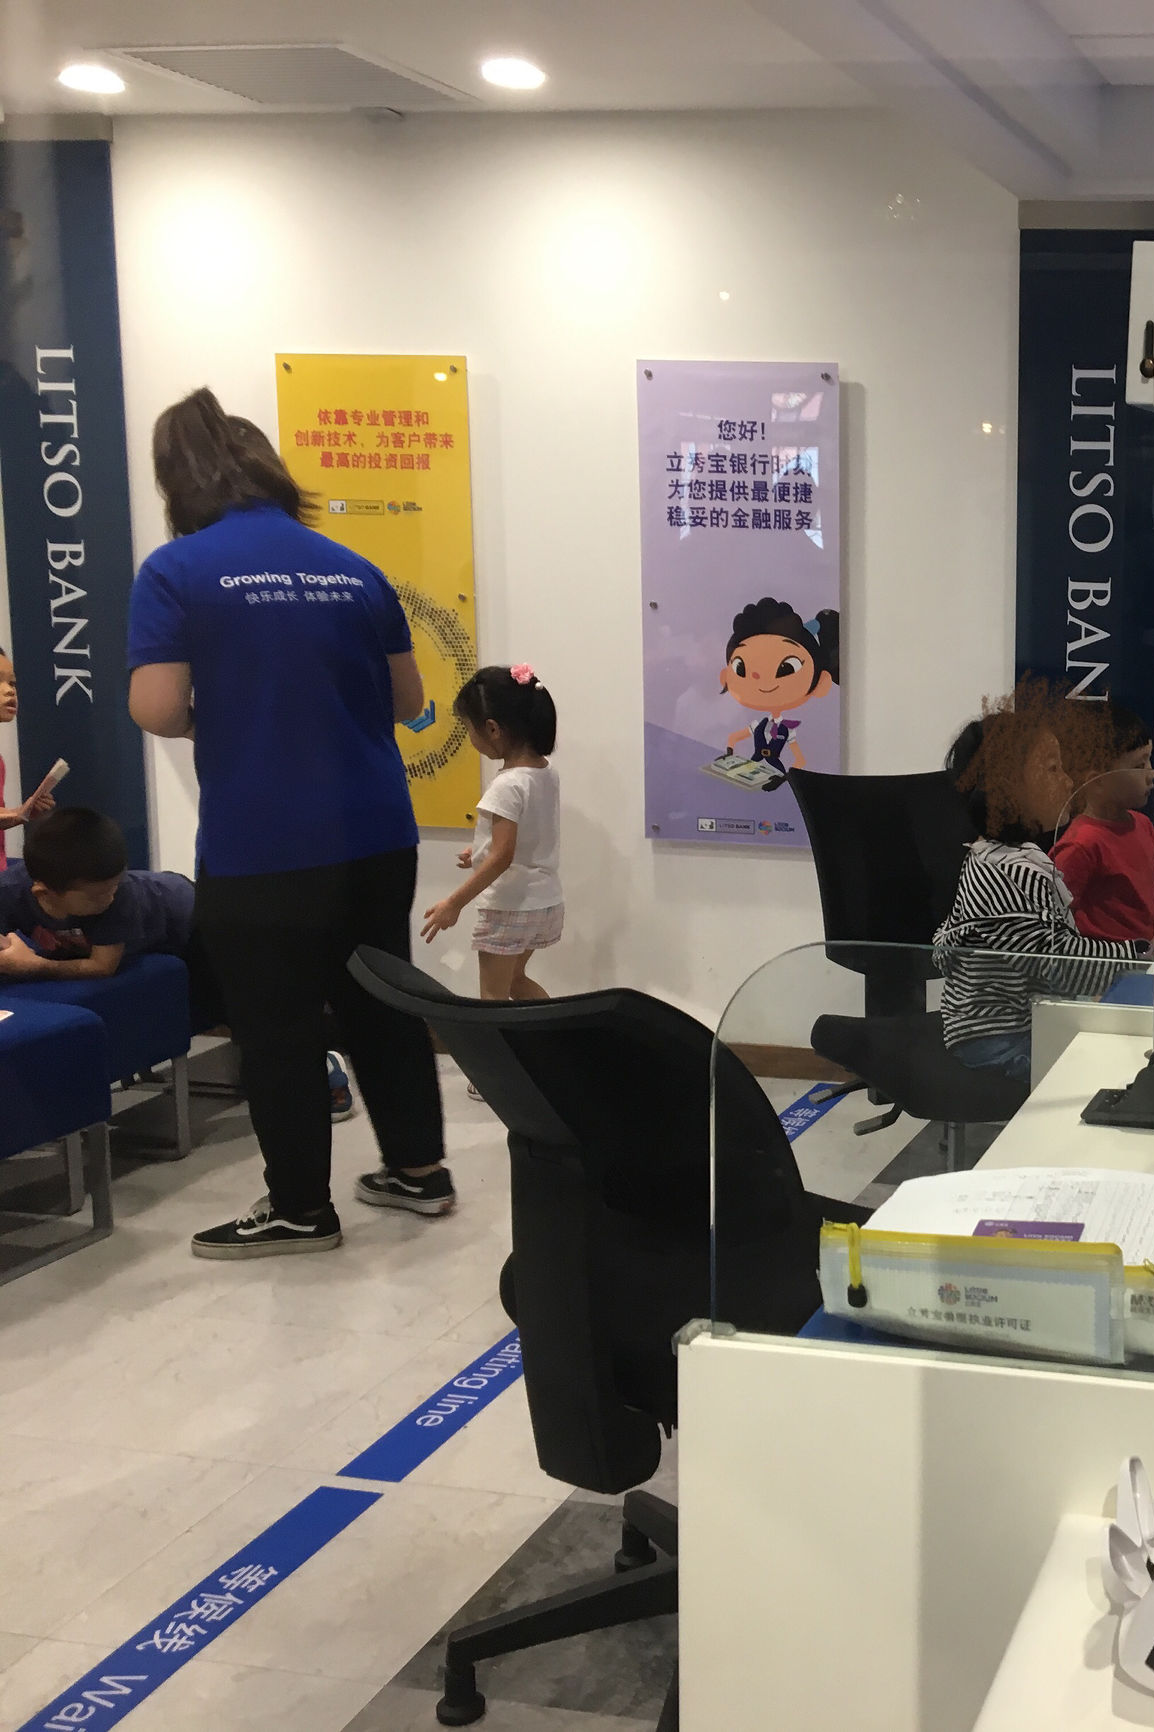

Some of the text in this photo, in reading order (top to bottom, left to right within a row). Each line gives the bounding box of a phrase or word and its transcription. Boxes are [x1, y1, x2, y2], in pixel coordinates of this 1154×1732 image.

[317, 408, 429, 427] 依靠专业管理和
[320, 451, 431, 471] 最高的投资回报
[667, 479, 813, 504] 为您提供最便捷
[35, 345, 93, 706] LITSO BANK
[667, 505, 813, 530] 稳妥的金融服务
[1065, 364, 1117, 702] LITSO BAN
[219, 571, 293, 588] Growing
[416, 1337, 522, 1427] aiting line
[136, 1564, 278, 1653] 等候线
